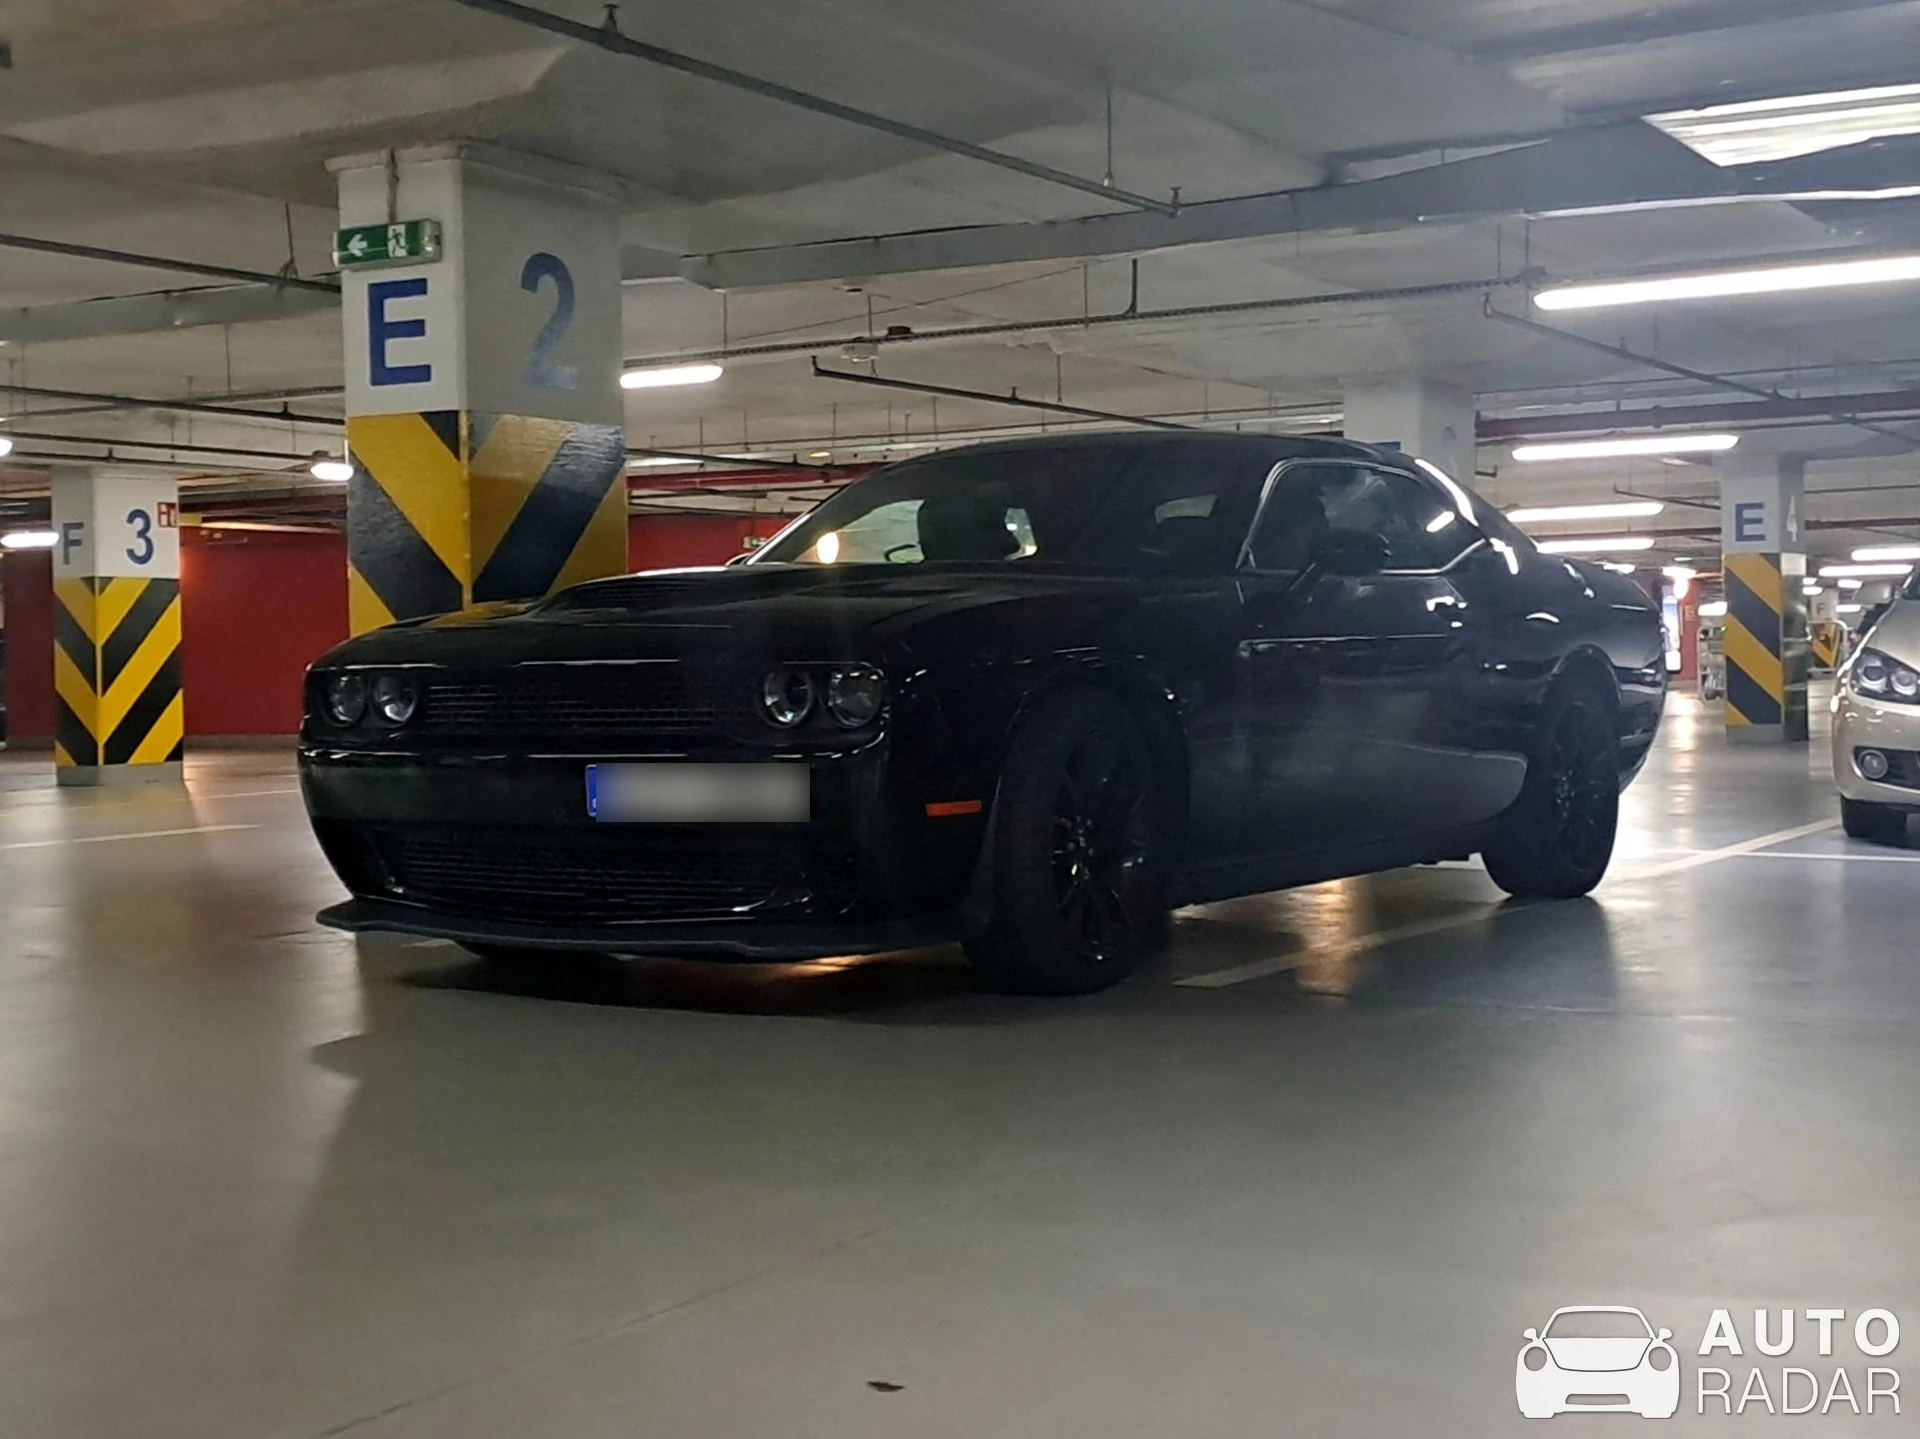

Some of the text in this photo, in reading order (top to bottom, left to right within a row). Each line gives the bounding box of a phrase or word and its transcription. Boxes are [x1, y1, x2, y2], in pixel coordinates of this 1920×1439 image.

[368, 278, 431, 386] E
[521, 252, 579, 389] 2
[62, 522, 84, 565] F
[126, 508, 154, 565] 3
[1735, 502, 1766, 542] E
